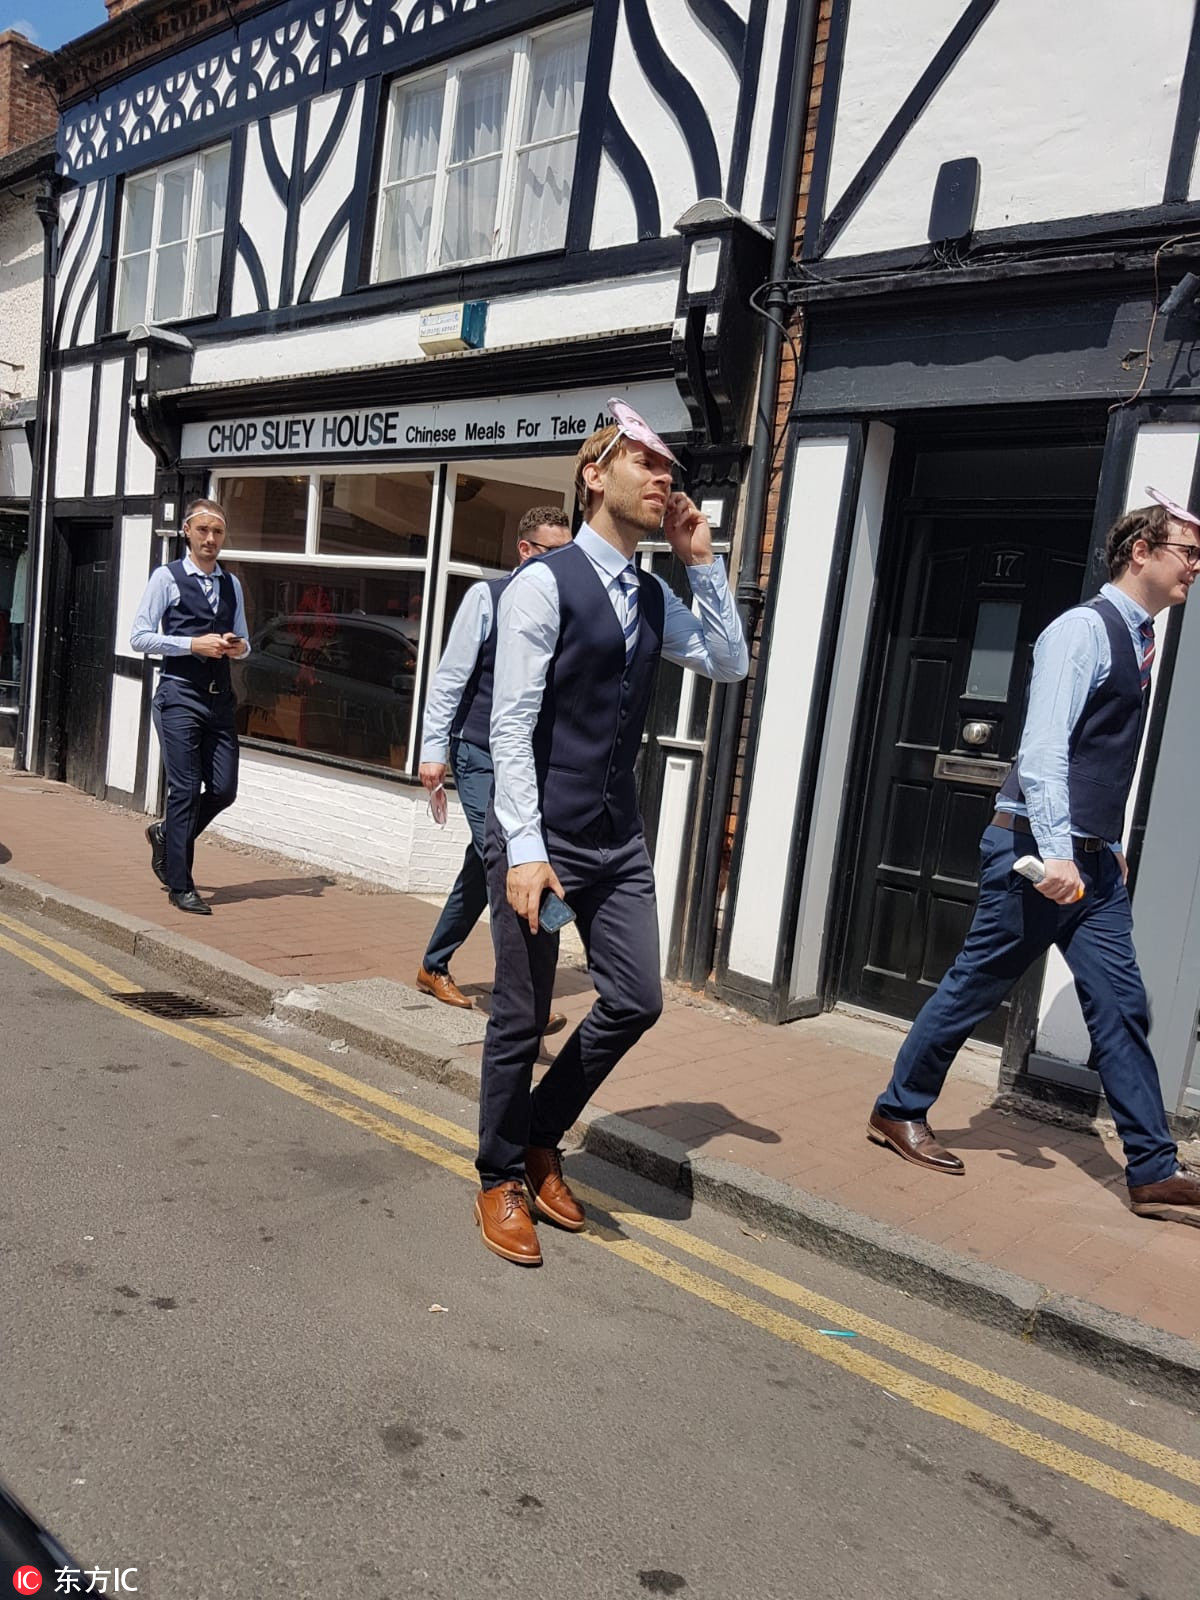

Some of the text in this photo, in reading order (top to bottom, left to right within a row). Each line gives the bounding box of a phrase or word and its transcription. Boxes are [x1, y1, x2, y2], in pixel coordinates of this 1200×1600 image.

[208, 412, 620, 453] CHOP SUEY HOUSE Chinese Meals For Take Aw
[995, 554, 1019, 577] 17
